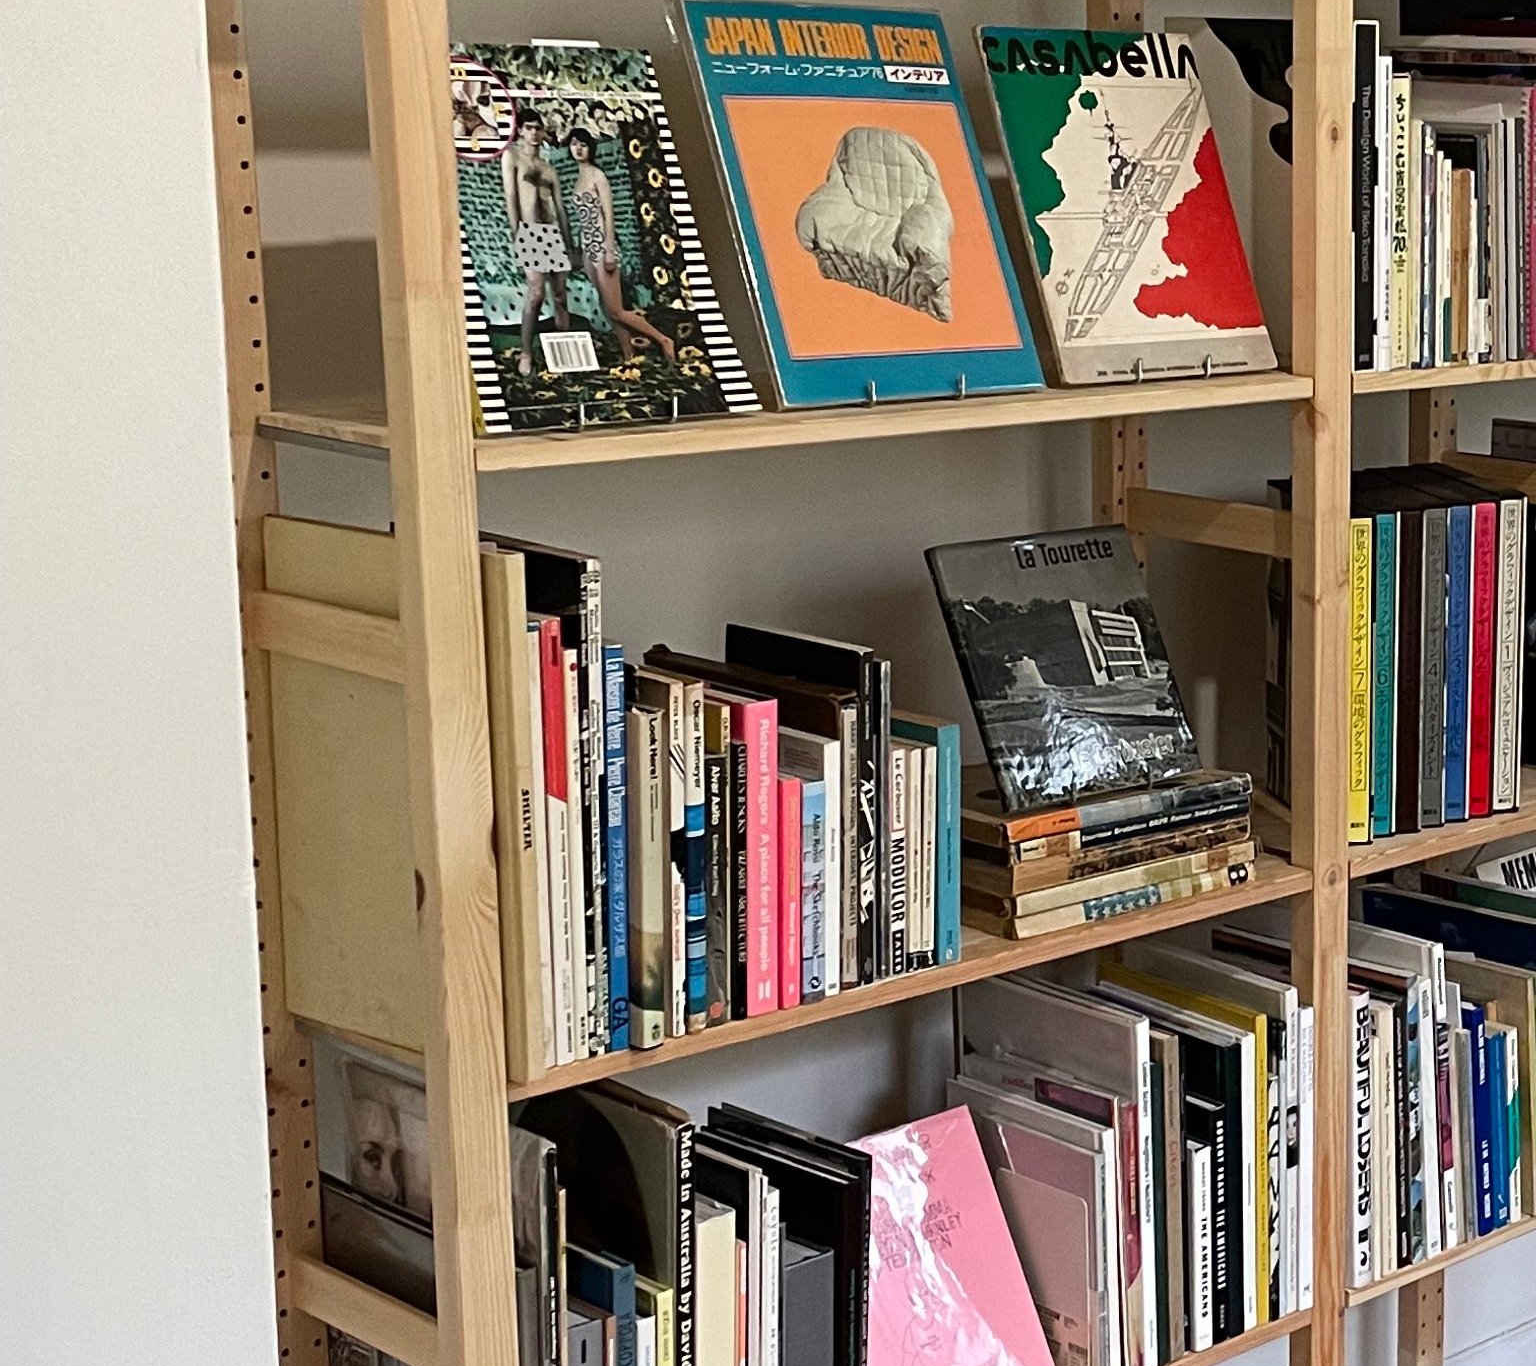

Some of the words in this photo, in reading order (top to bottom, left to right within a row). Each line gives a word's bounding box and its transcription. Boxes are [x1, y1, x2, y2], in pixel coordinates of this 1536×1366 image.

[705, 17, 777, 57] JAPAN
[777, 19, 872, 60] INTERIOR
[872, 25, 945, 65] DESIGN
[889, 69, 946, 83] インテリア
[1361, 85, 1371, 110] The
[1361, 110, 1371, 154] Design
[1361, 156, 1371, 195] World
[1039, 537, 1114, 568] Tourette
[606, 657, 622, 670] La
[1377, 668, 1388, 685] 6
[1427, 662, 1438, 678] 4
[1451, 659, 1462, 675] 3
[607, 671, 623, 710] Maison
[1355, 672, 1365, 689] 7
[607, 710, 622, 723] de
[692, 699, 702, 733] Oscar
[607, 723, 624, 751] Verre
[649, 717, 659, 747] Look
[758, 718, 770, 768] Richard
[608, 757, 625, 786] Pierre
[650, 748, 660, 780] Here!
[693, 736, 703, 789] Niemeyer
[711, 765, 721, 795] Alvar
[711, 796, 721, 825] Aalto
[757, 771, 770, 825] Rogers
[894, 774, 904, 825] Corbusier
[521, 788, 533, 853] SHELTER
[812, 814, 822, 837] Aldo
[757, 846, 770, 883] place
[812, 838, 822, 864] Rossi
[759, 884, 770, 906] for
[812, 872, 822, 892] The
[891, 837, 905, 924] MODULOR
[759, 908, 770, 924] all
[757, 927, 770, 972] people
[611, 996, 629, 1033] GA
[1356, 1005, 1371, 1128] BEAUTIFUL
[681, 1129, 694, 1182] Made
[1216, 1121, 1226, 1163] ROBERT
[1356, 1129, 1371, 1217] LOSERS
[681, 1184, 693, 1203] in
[1201, 1217, 1209, 1239] THE
[680, 1207, 693, 1289] Australia
[1201, 1245, 1209, 1318] AMERICANS
[678, 1291, 692, 1313] by
